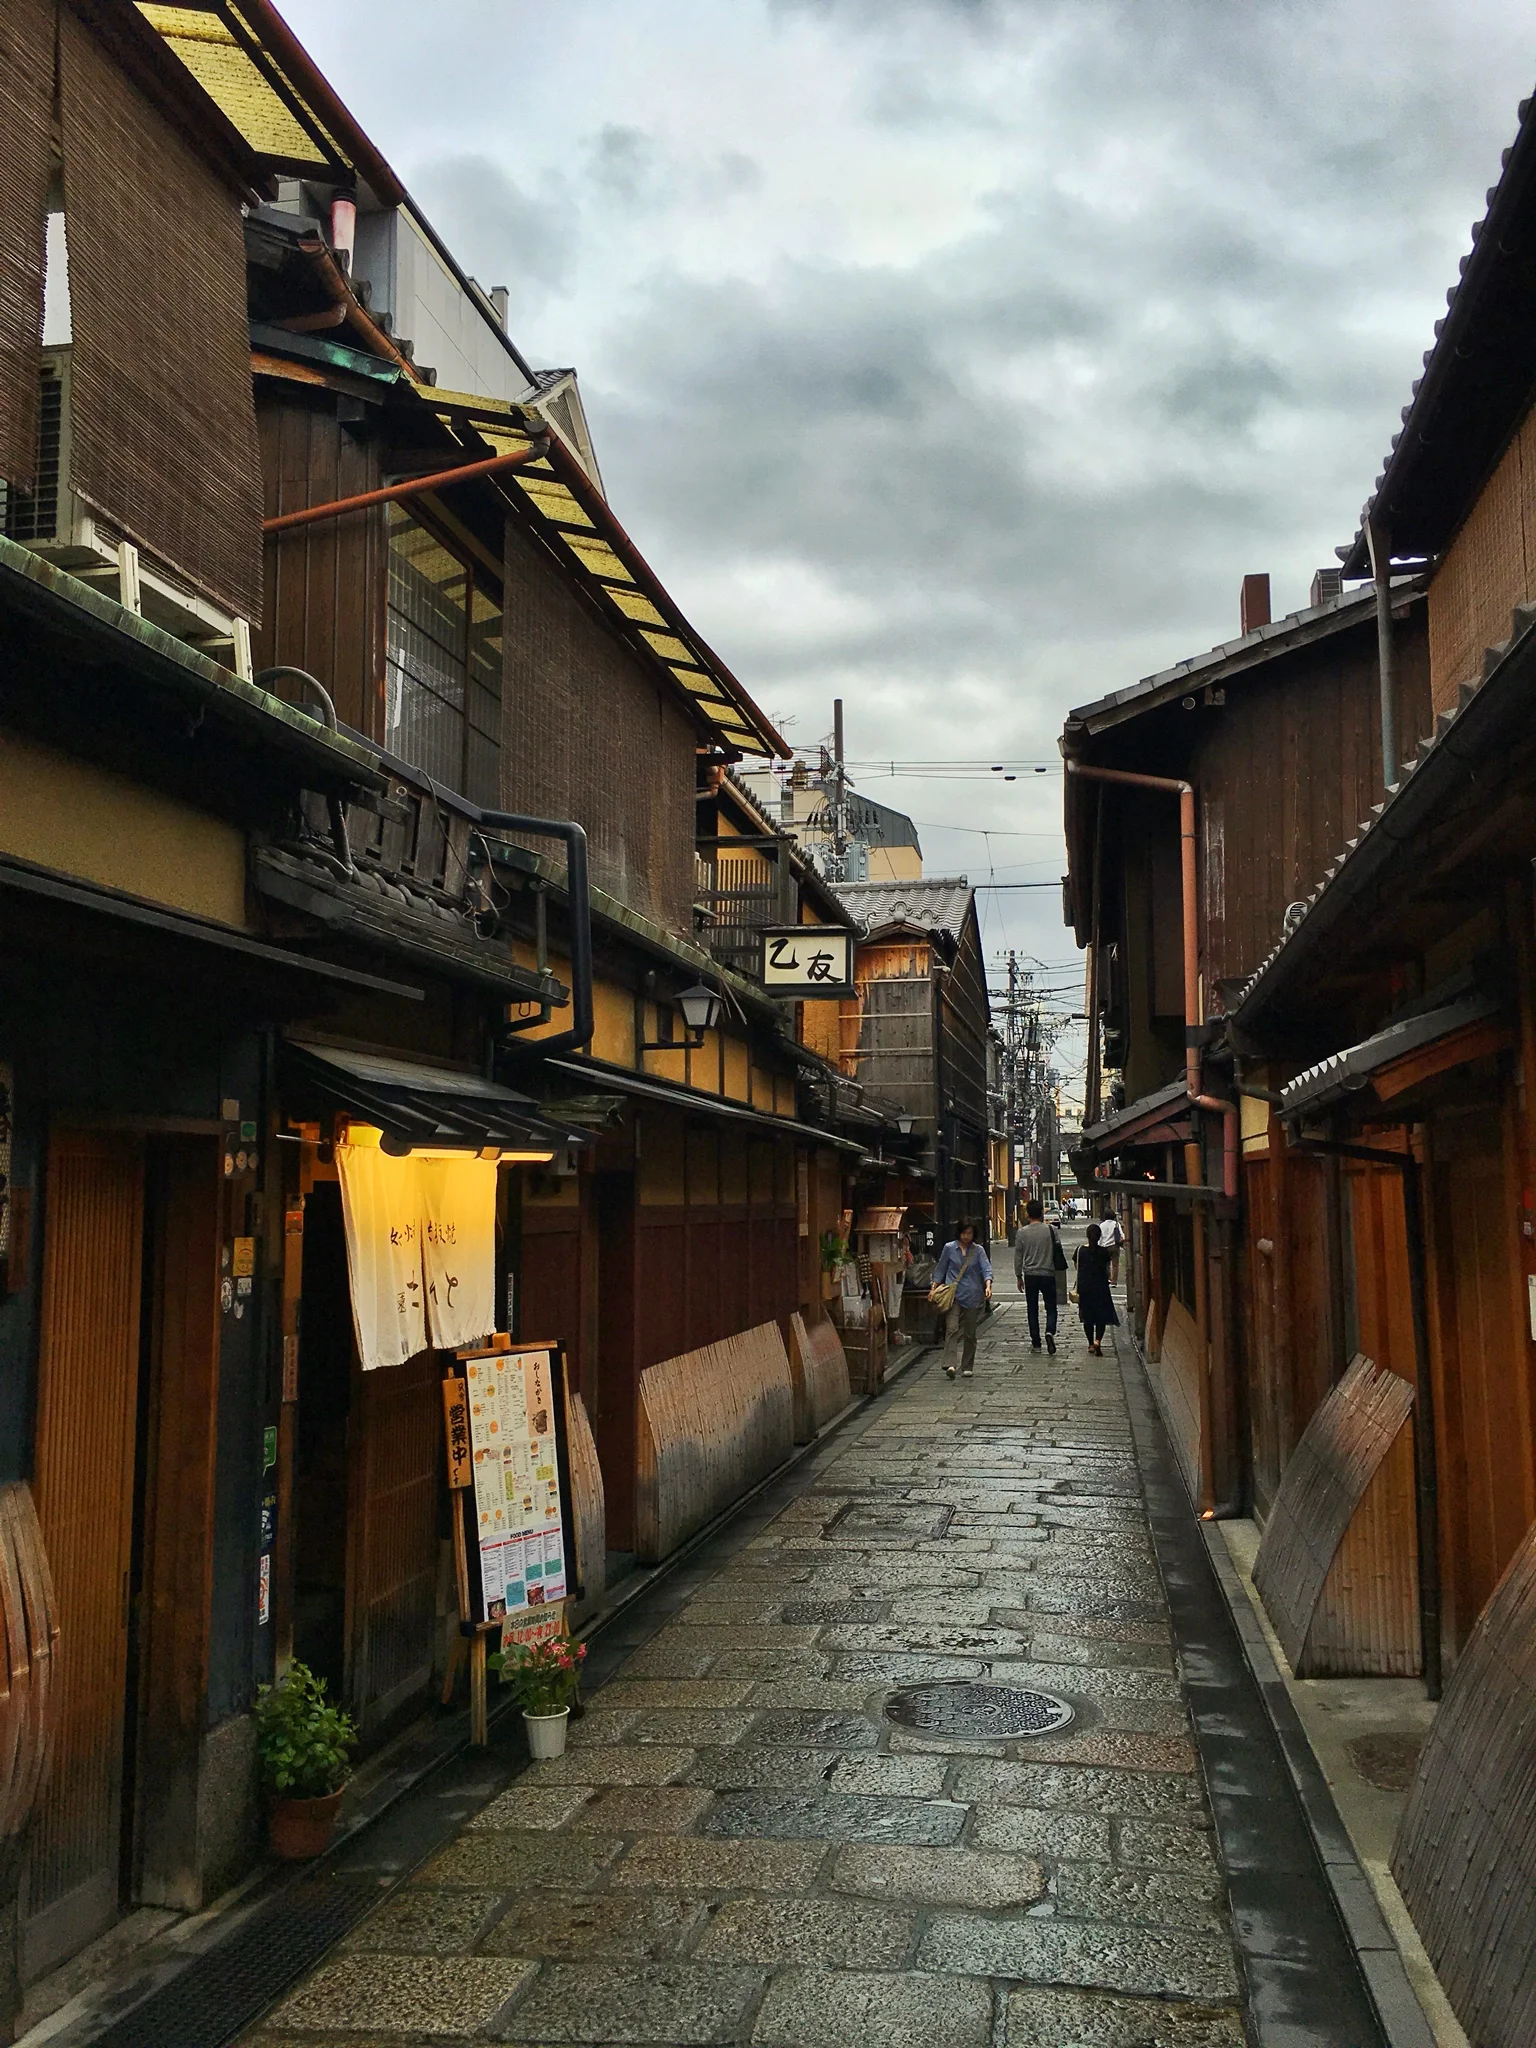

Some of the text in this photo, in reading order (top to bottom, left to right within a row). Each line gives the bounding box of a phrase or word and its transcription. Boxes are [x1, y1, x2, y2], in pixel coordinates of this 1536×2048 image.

[769, 938, 843, 982] 乙友
[533, 1362, 543, 1405] おしながき
